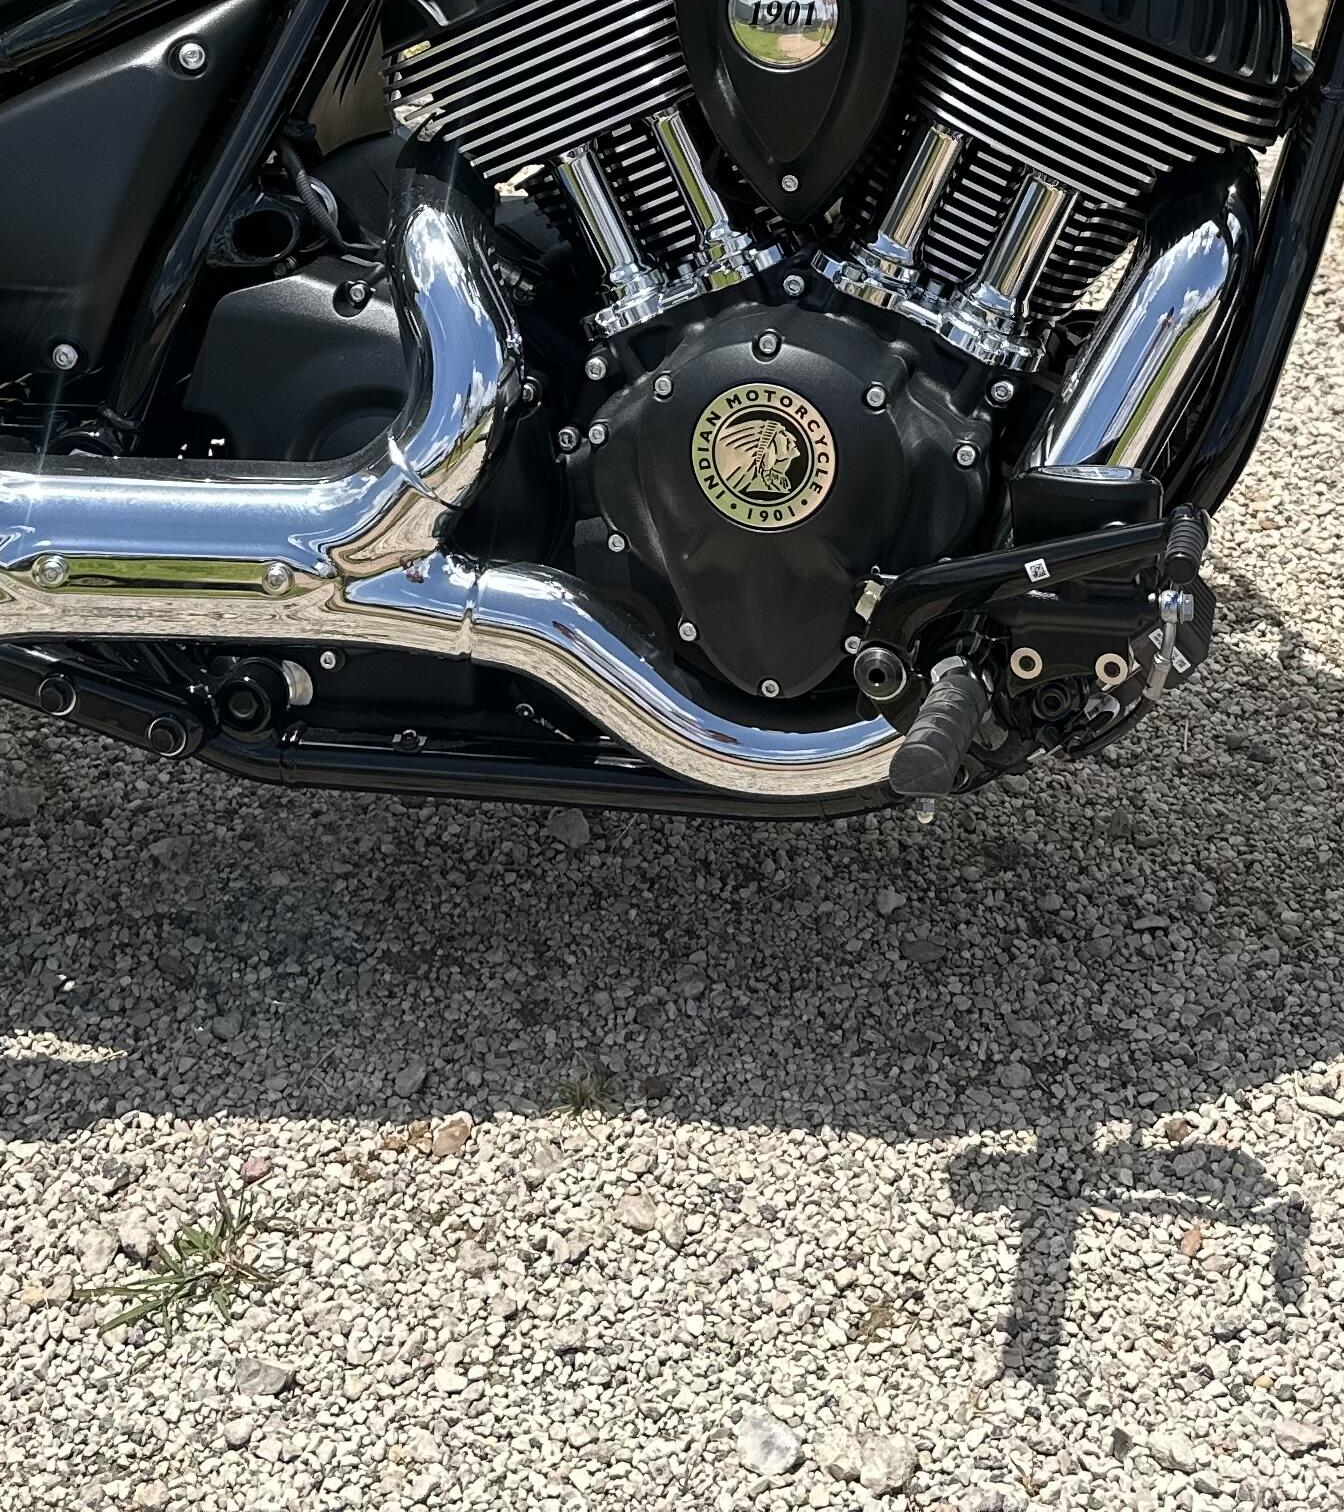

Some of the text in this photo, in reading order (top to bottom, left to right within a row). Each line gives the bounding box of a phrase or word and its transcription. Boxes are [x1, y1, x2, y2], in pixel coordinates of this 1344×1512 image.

[749, 0, 816, 26] 1901
[697, 389, 830, 500] INDIAN MOTORCYCLE
[747, 505, 796, 522] 1901
